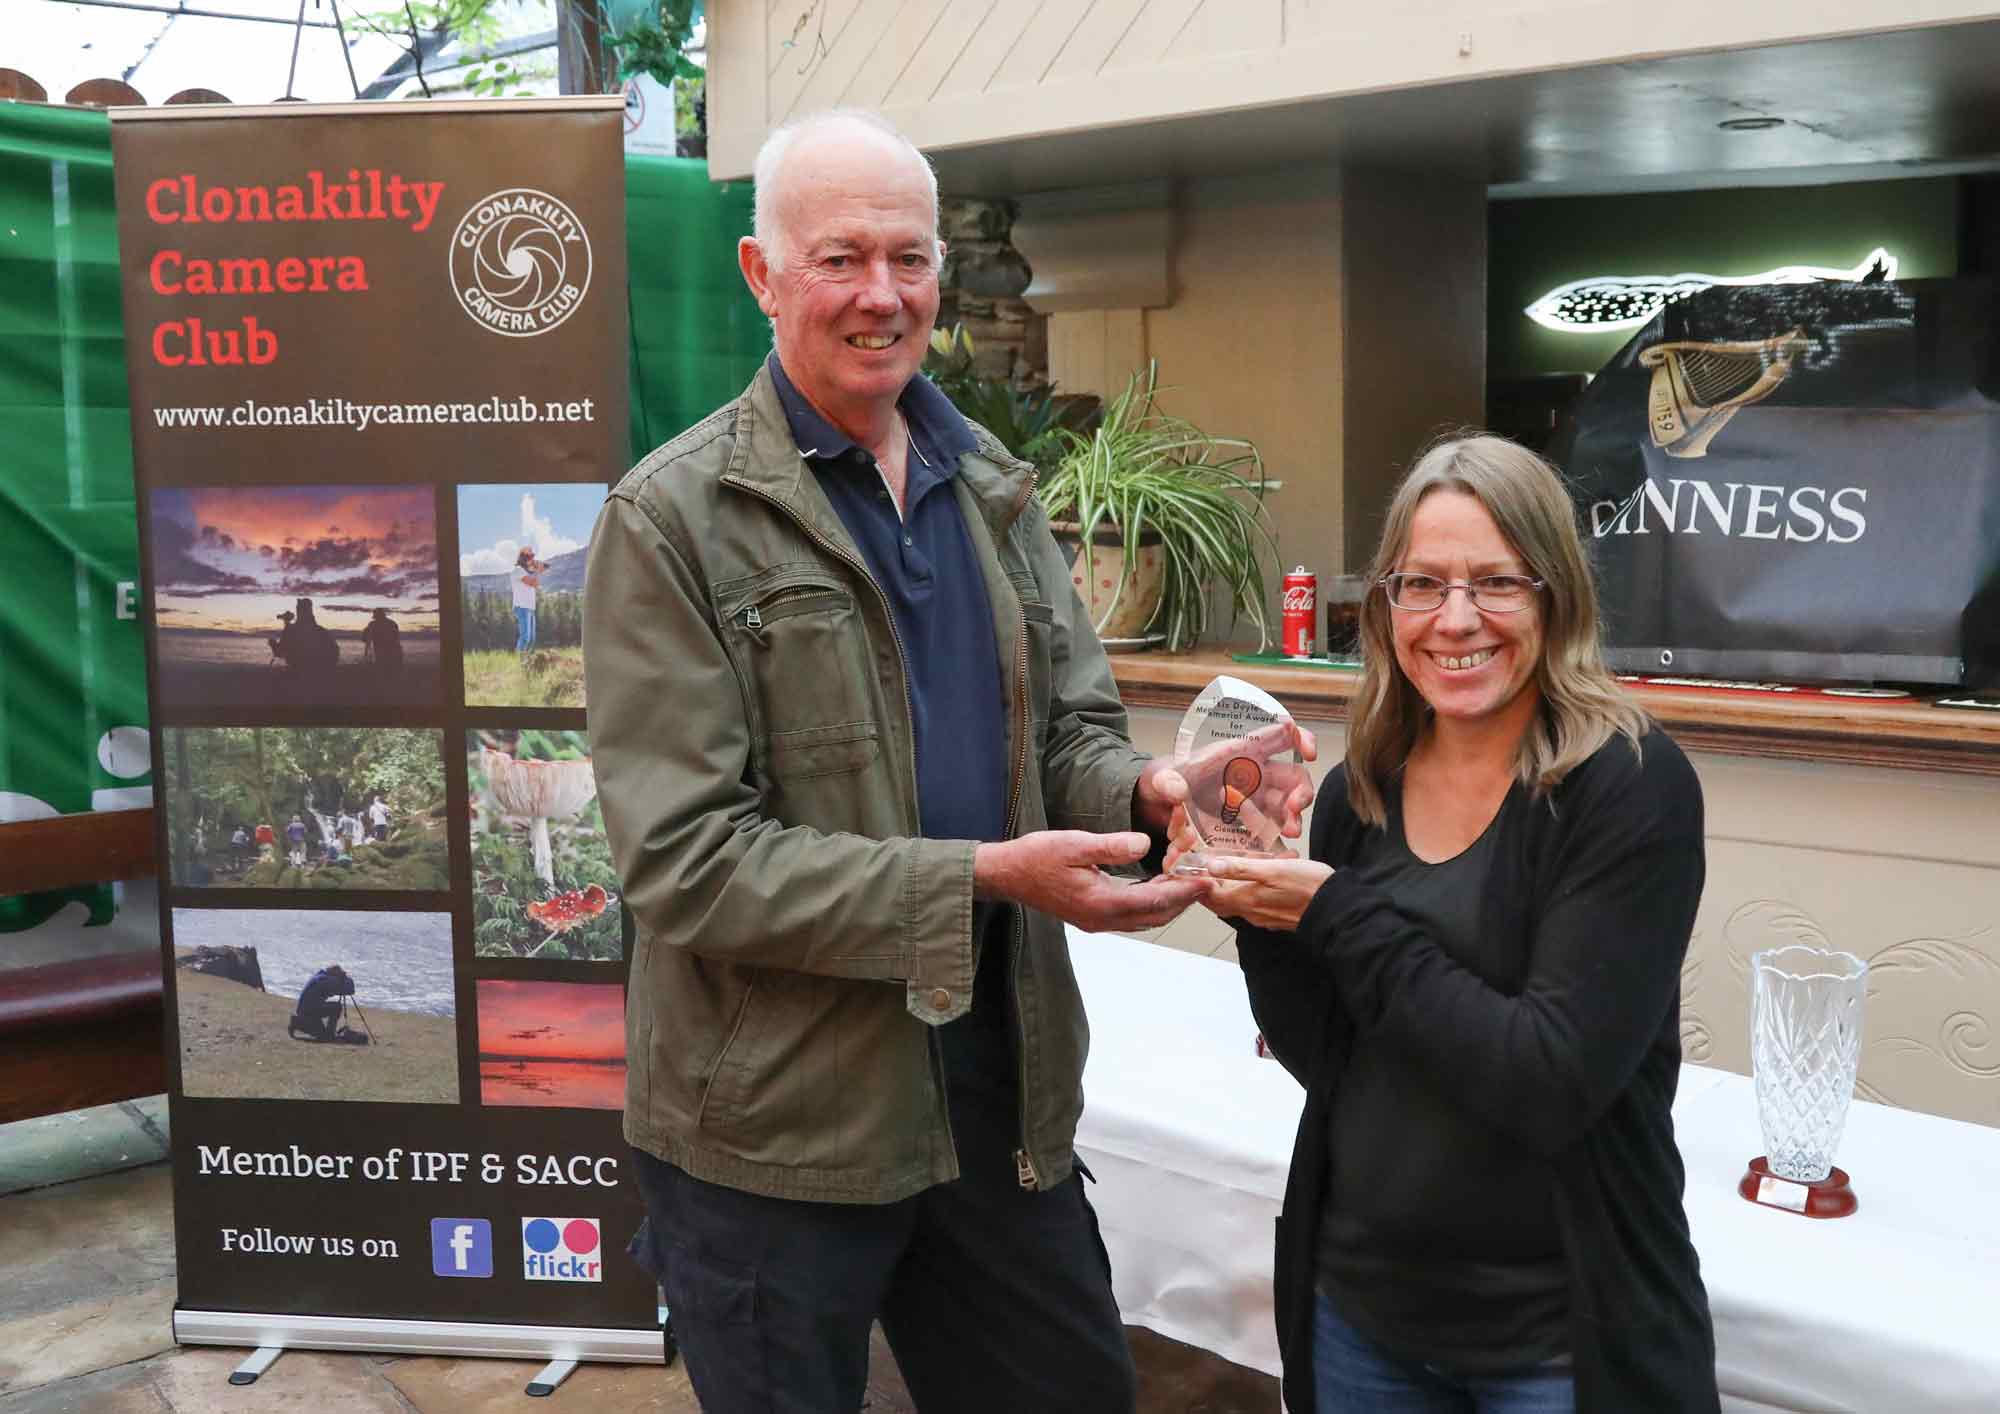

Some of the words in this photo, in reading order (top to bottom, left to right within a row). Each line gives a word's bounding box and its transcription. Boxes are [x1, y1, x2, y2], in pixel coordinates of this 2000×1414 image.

[146, 170, 445, 232] Clonakilty
[460, 195, 581, 248] CLONAKILTY
[150, 249, 369, 295] Camera
[464, 287, 537, 330] CAMERA
[539, 283, 580, 323] CLUB
[153, 316, 279, 366] Club
[153, 396, 594, 431] www.clonakiltycameraclub.net
[1230, 721, 1243, 730] for
[198, 1146, 353, 1180] Member
[363, 1148, 403, 1181] of
[411, 1152, 470, 1182] IPF
[481, 1154, 505, 1185] &
[517, 1155, 620, 1187] SACC
[221, 1228, 315, 1256] Follow
[322, 1237, 355, 1257] us
[362, 1239, 400, 1259] on
[526, 1254, 600, 1278] flickr
